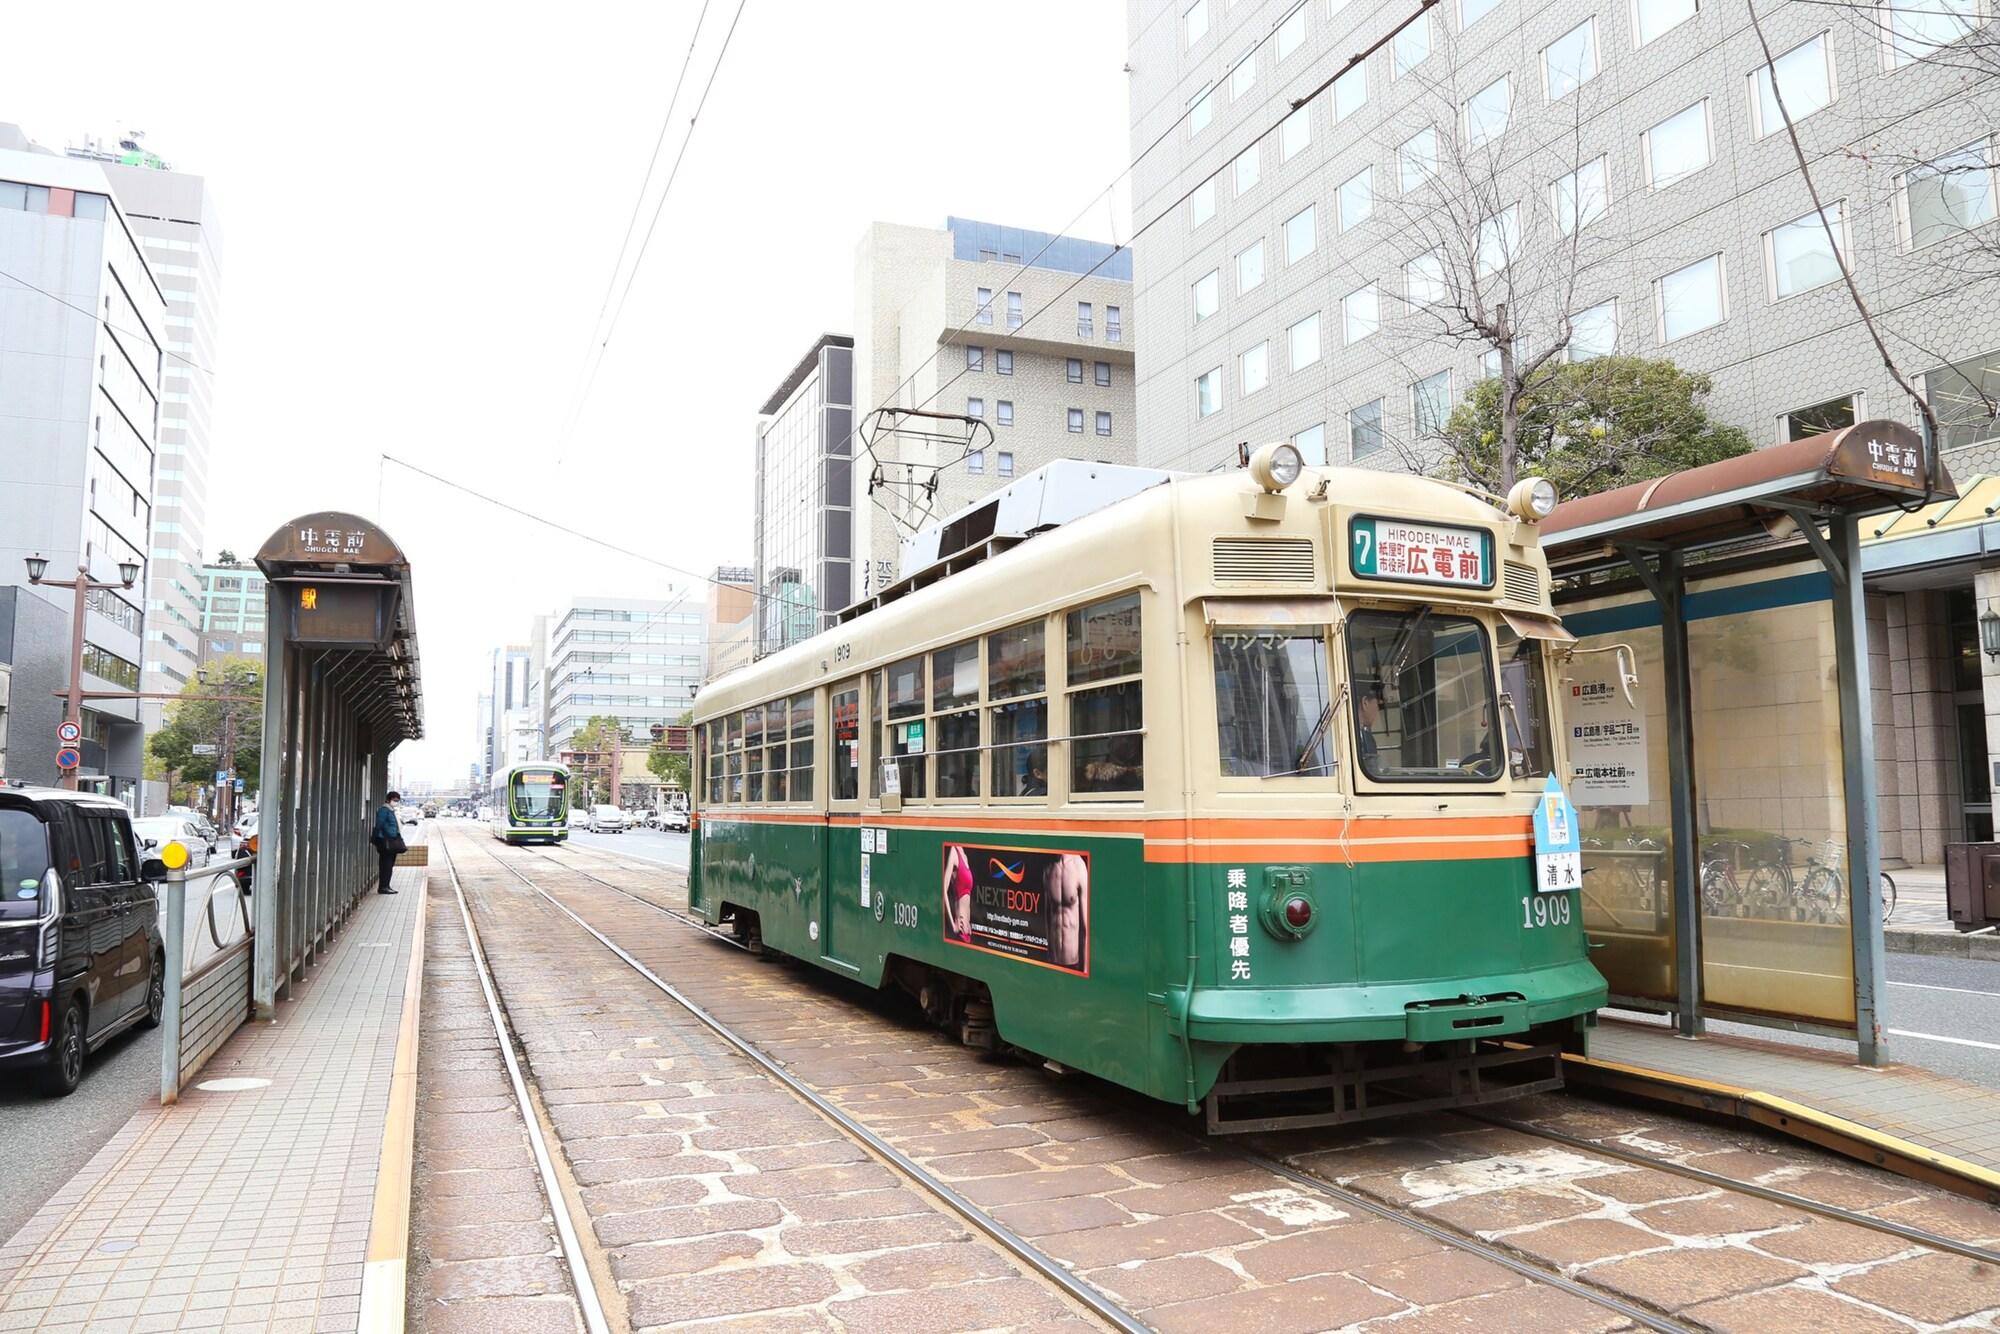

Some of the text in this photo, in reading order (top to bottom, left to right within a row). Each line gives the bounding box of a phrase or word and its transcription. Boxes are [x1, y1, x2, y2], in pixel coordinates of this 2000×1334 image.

[1901, 467, 1915, 477] MAE
[1355, 529, 1371, 565] 7
[1378, 541, 1406, 558] 紙屋町
[1388, 528, 1470, 549] HIRODEN-MAE
[1379, 558, 1406, 574] 市役所
[1407, 545, 1479, 580] 広電前
[1222, 633, 1292, 650] ワンマン
[834, 643, 850, 664] 1909
[1547, 863, 1575, 886] 清水
[894, 903, 918, 928] 1909
[1522, 896, 1570, 928] 1909
[1227, 869, 1251, 980] 乗降者優先
